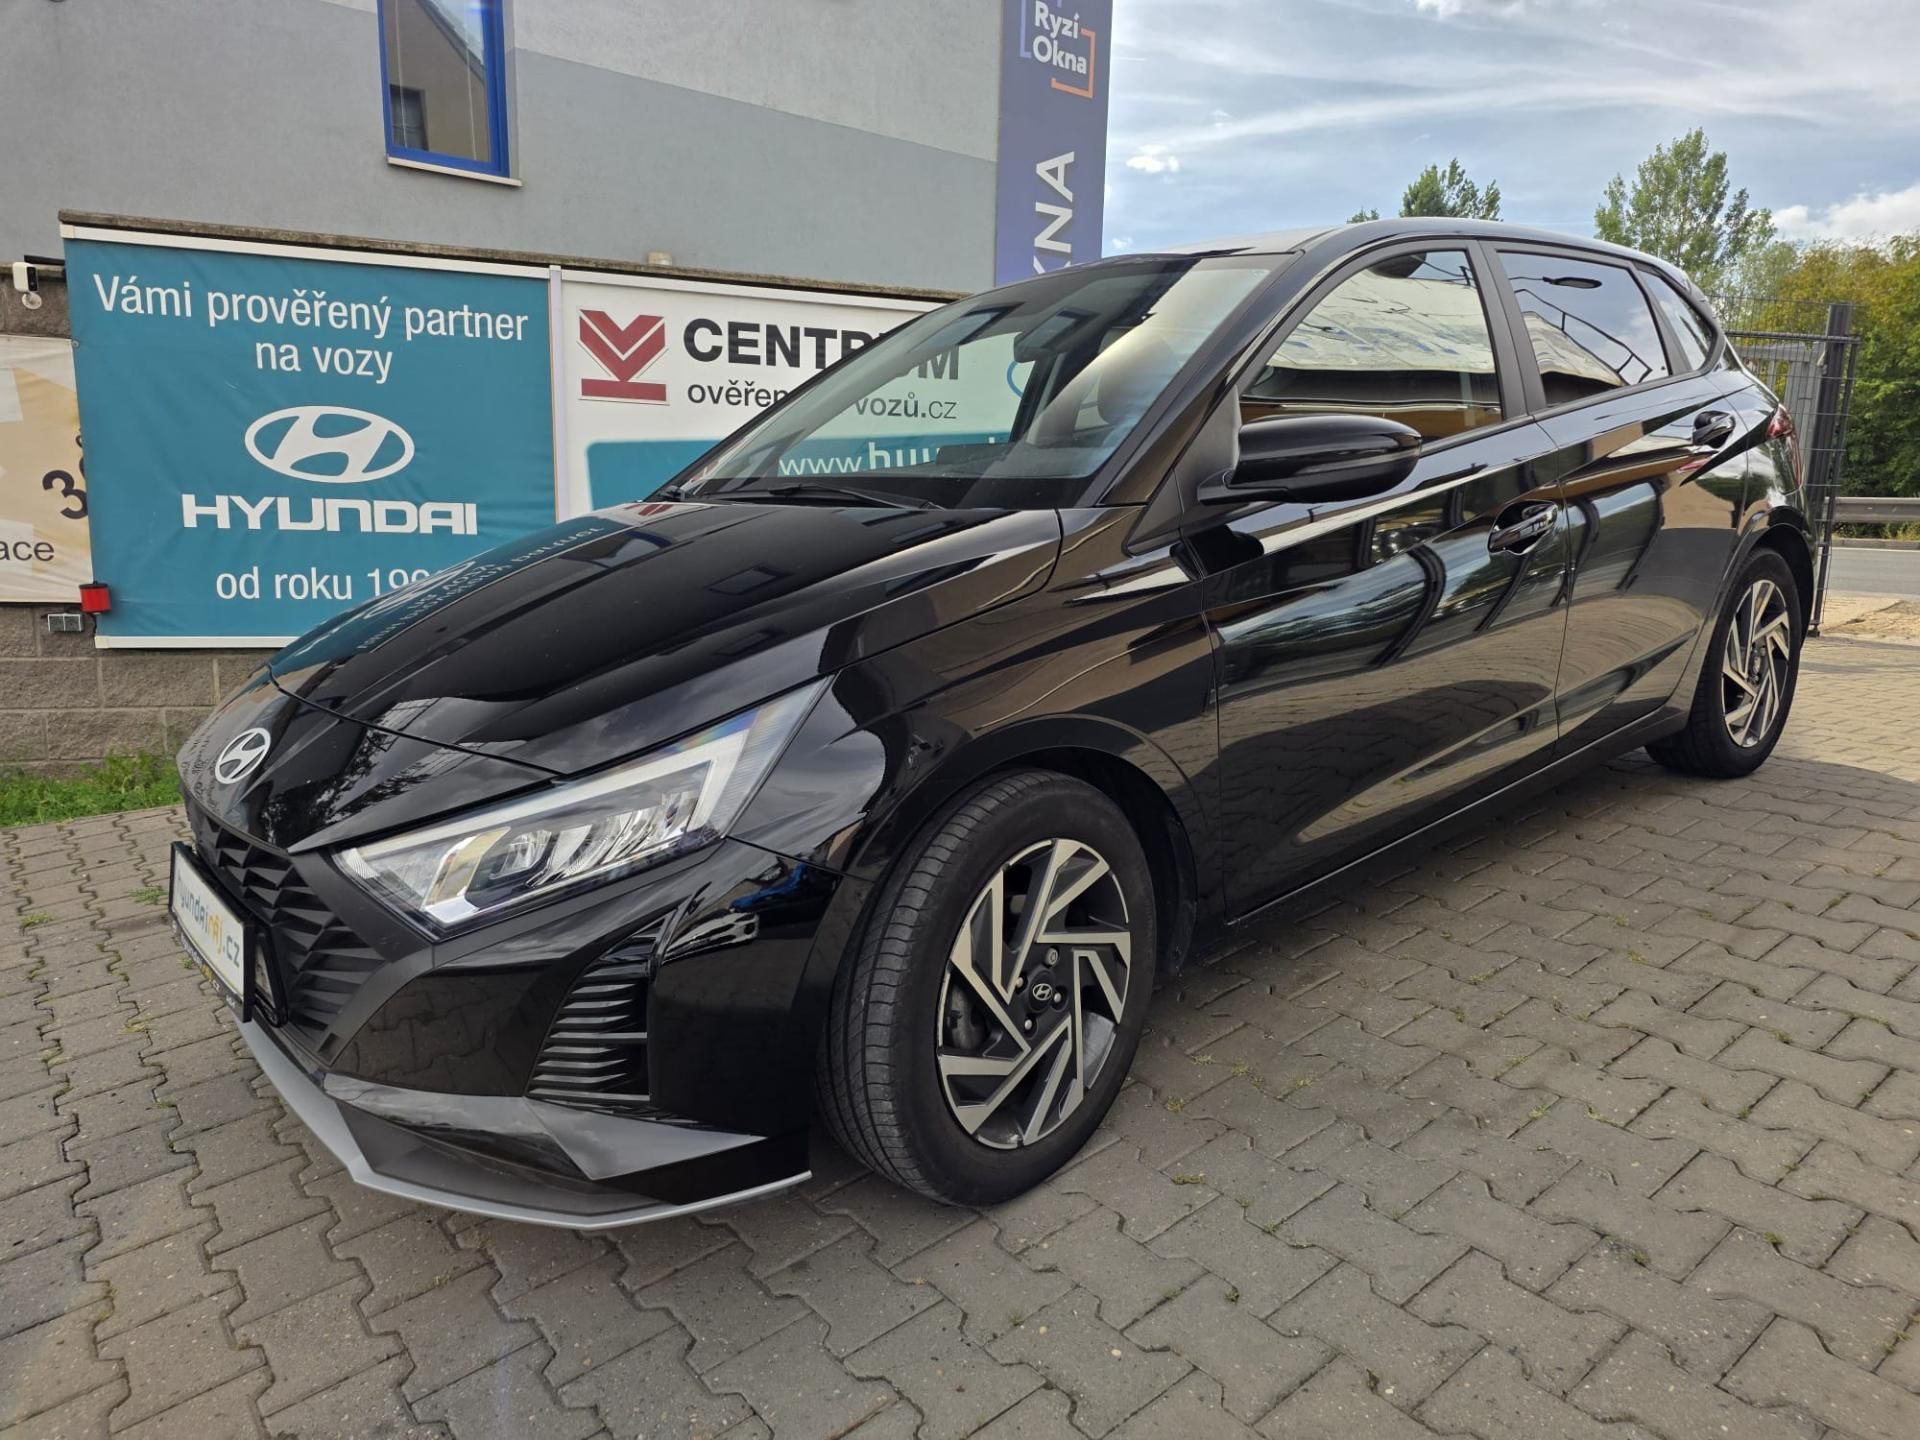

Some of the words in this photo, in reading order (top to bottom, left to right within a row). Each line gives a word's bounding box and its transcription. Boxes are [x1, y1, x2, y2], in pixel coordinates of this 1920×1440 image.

[1035, 0, 1079, 39] Ryzí
[1033, 35, 1087, 74] Okna
[93, 274, 192, 318] Vámi
[207, 288, 391, 339] prověřený
[405, 304, 528, 341] partner
[255, 342, 302, 372] na
[312, 346, 392, 384] vozy
[855, 391, 957, 419] vozů.cz
[182, 494, 477, 535] HYUNDAI
[216, 566, 260, 599] od
[274, 567, 352, 600] roku
